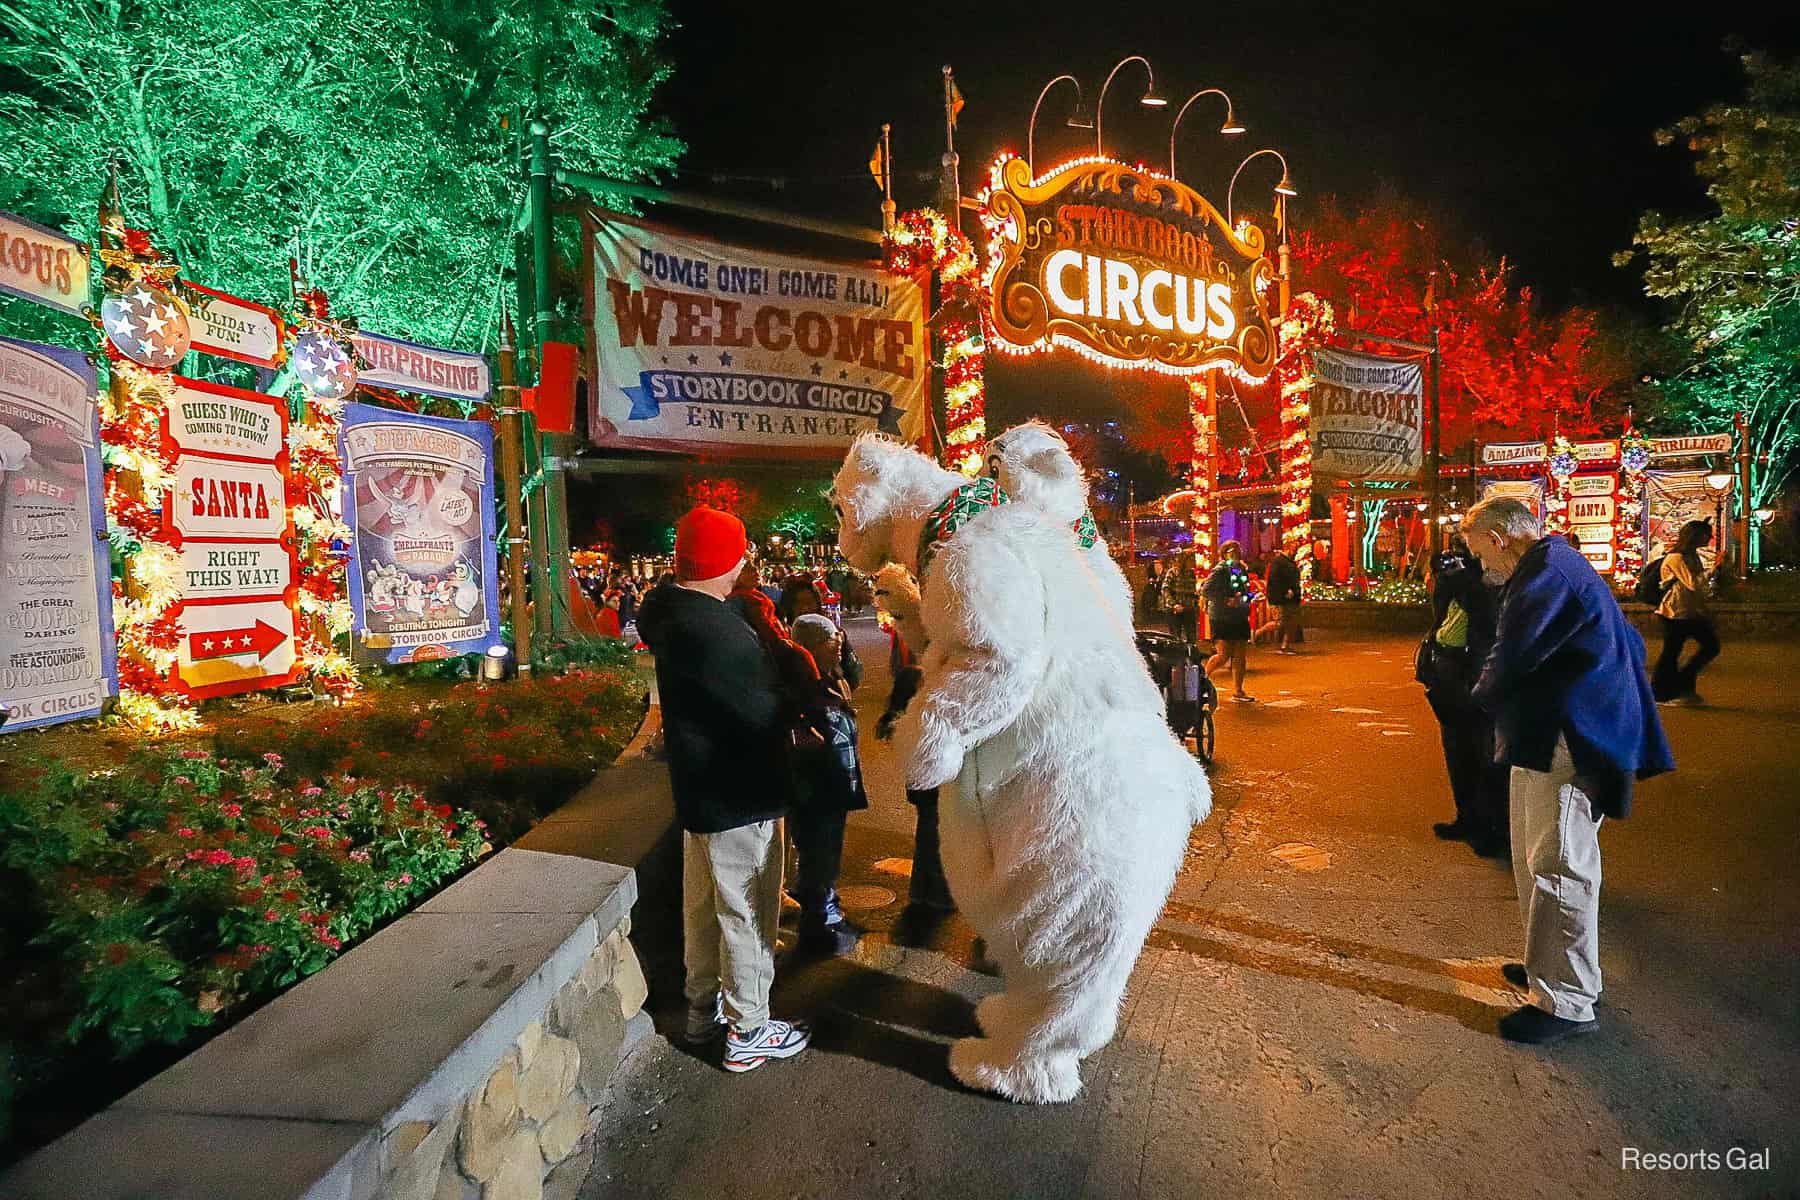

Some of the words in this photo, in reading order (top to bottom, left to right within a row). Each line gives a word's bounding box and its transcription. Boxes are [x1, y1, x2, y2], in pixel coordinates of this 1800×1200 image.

[1056, 203, 1214, 276] STORYBOOK
[640, 248, 708, 290] COME
[717, 265, 769, 296] ONE!
[778, 269, 837, 300] COME
[844, 277, 889, 309] ALL!
[1045, 249, 1236, 340] CIRCUS
[190, 307, 256, 335] HOLIDAY
[607, 279, 914, 379] WELCOME
[206, 325, 241, 344] FUN!
[653, 374, 799, 407] STORYBOOK
[807, 384, 884, 415] CIRCUS
[182, 403, 227, 420] GUESS
[230, 406, 270, 432] WHO'S
[185, 422, 222, 434] COMING
[225, 424, 236, 435] TO
[238, 427, 269, 446] TOWN!
[374, 429, 460, 459] DUMBO
[1488, 446, 1542, 460] AMAZING
[1653, 438, 1725, 452] THRILLING
[25, 479, 64, 498] MEET
[192, 477, 270, 519] SANTA
[440, 498, 465, 512] LATEST
[27, 511, 65, 519] MADAME
[1575, 504, 1607, 517] SANTA
[12, 519, 81, 536] DAISY
[208, 551, 260, 567] RIGHT
[186, 570, 232, 587] THIS
[237, 569, 279, 586] WAY!
[19, 599, 41, 610] THE
[42, 598, 74, 608] GREAT
[24, 627, 76, 639] DARING
[389, 621, 428, 632] DEBUTING
[391, 631, 447, 645] STORYBOOK
[452, 627, 482, 639] CIRCUS
[10, 659, 29, 669] THE
[30, 652, 86, 668] ASTOUNDING
[41, 692, 97, 713] CIRCUS
